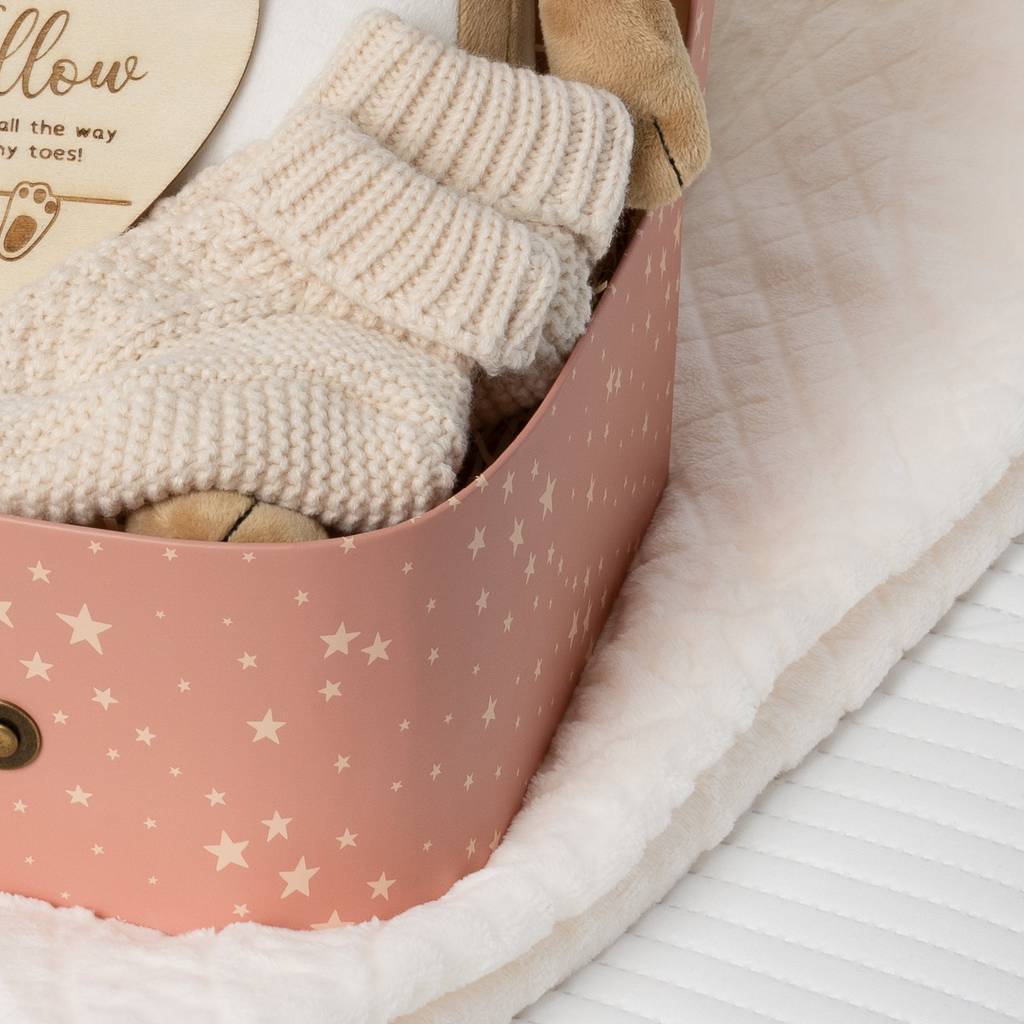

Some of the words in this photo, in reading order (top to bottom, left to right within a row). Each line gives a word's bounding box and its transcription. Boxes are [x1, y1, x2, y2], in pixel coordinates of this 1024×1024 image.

[30, 120, 65, 136] the
[76, 125, 117, 144] way
[29, 145, 83, 162] toes!
